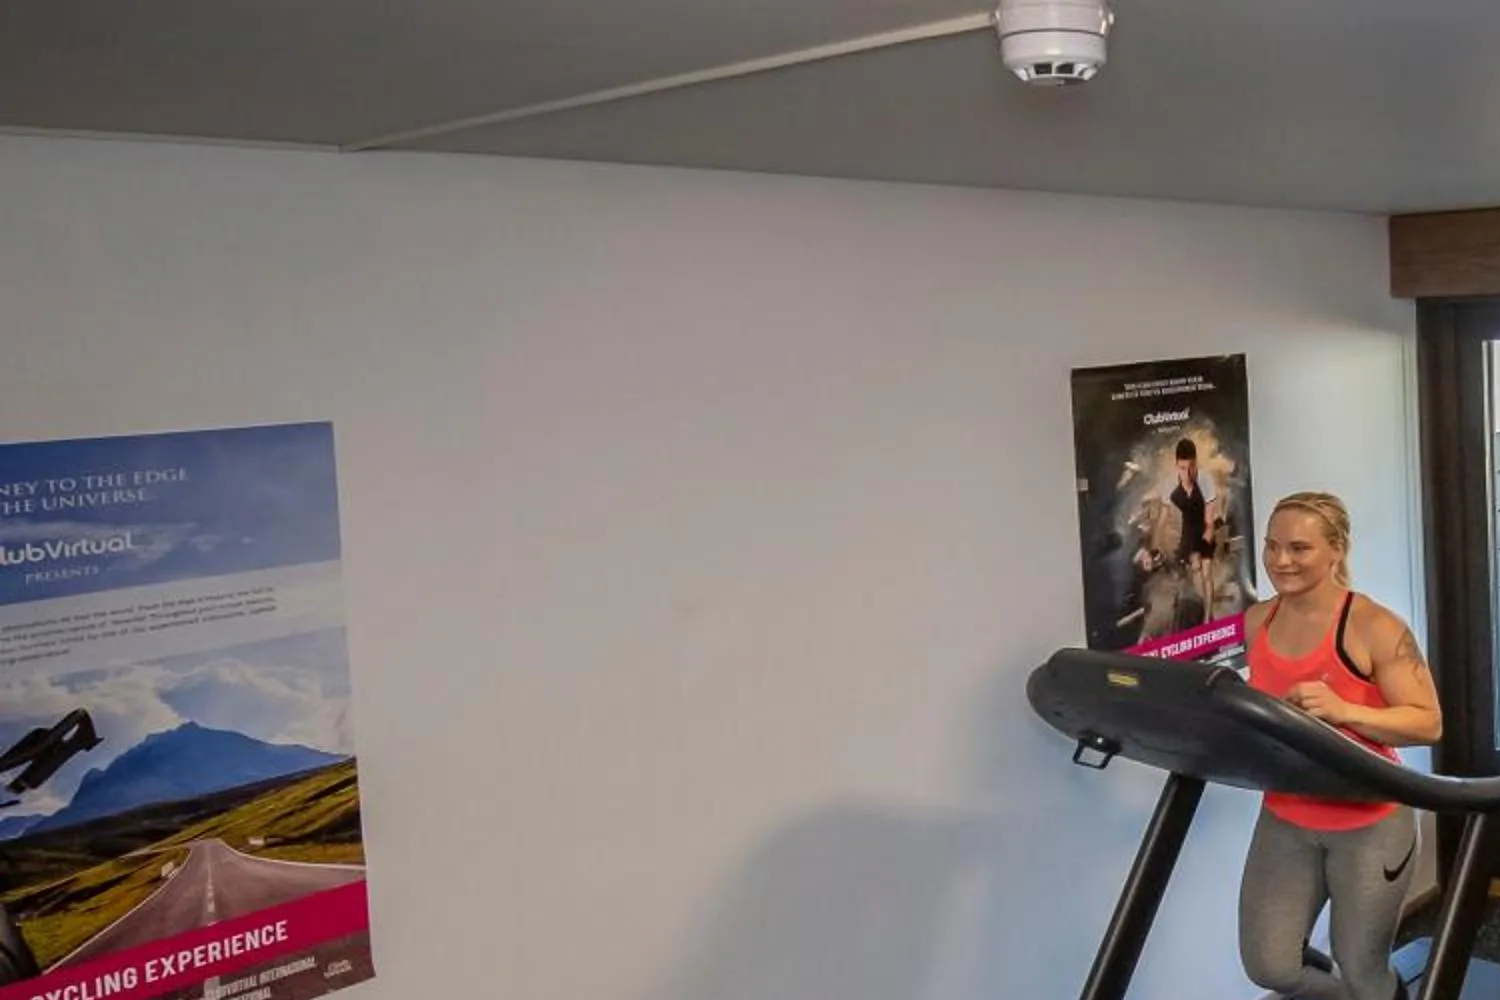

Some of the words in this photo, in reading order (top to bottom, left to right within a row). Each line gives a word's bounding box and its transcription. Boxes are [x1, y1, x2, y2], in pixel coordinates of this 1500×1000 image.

[45, 478, 77, 493] TO
[82, 474, 126, 489] THE
[134, 468, 188, 485] EDGE
[42, 487, 147, 511] UNIVERSE
[25, 565, 99, 587] PRESENTS
[145, 919, 289, 983] EXPERIENCE
